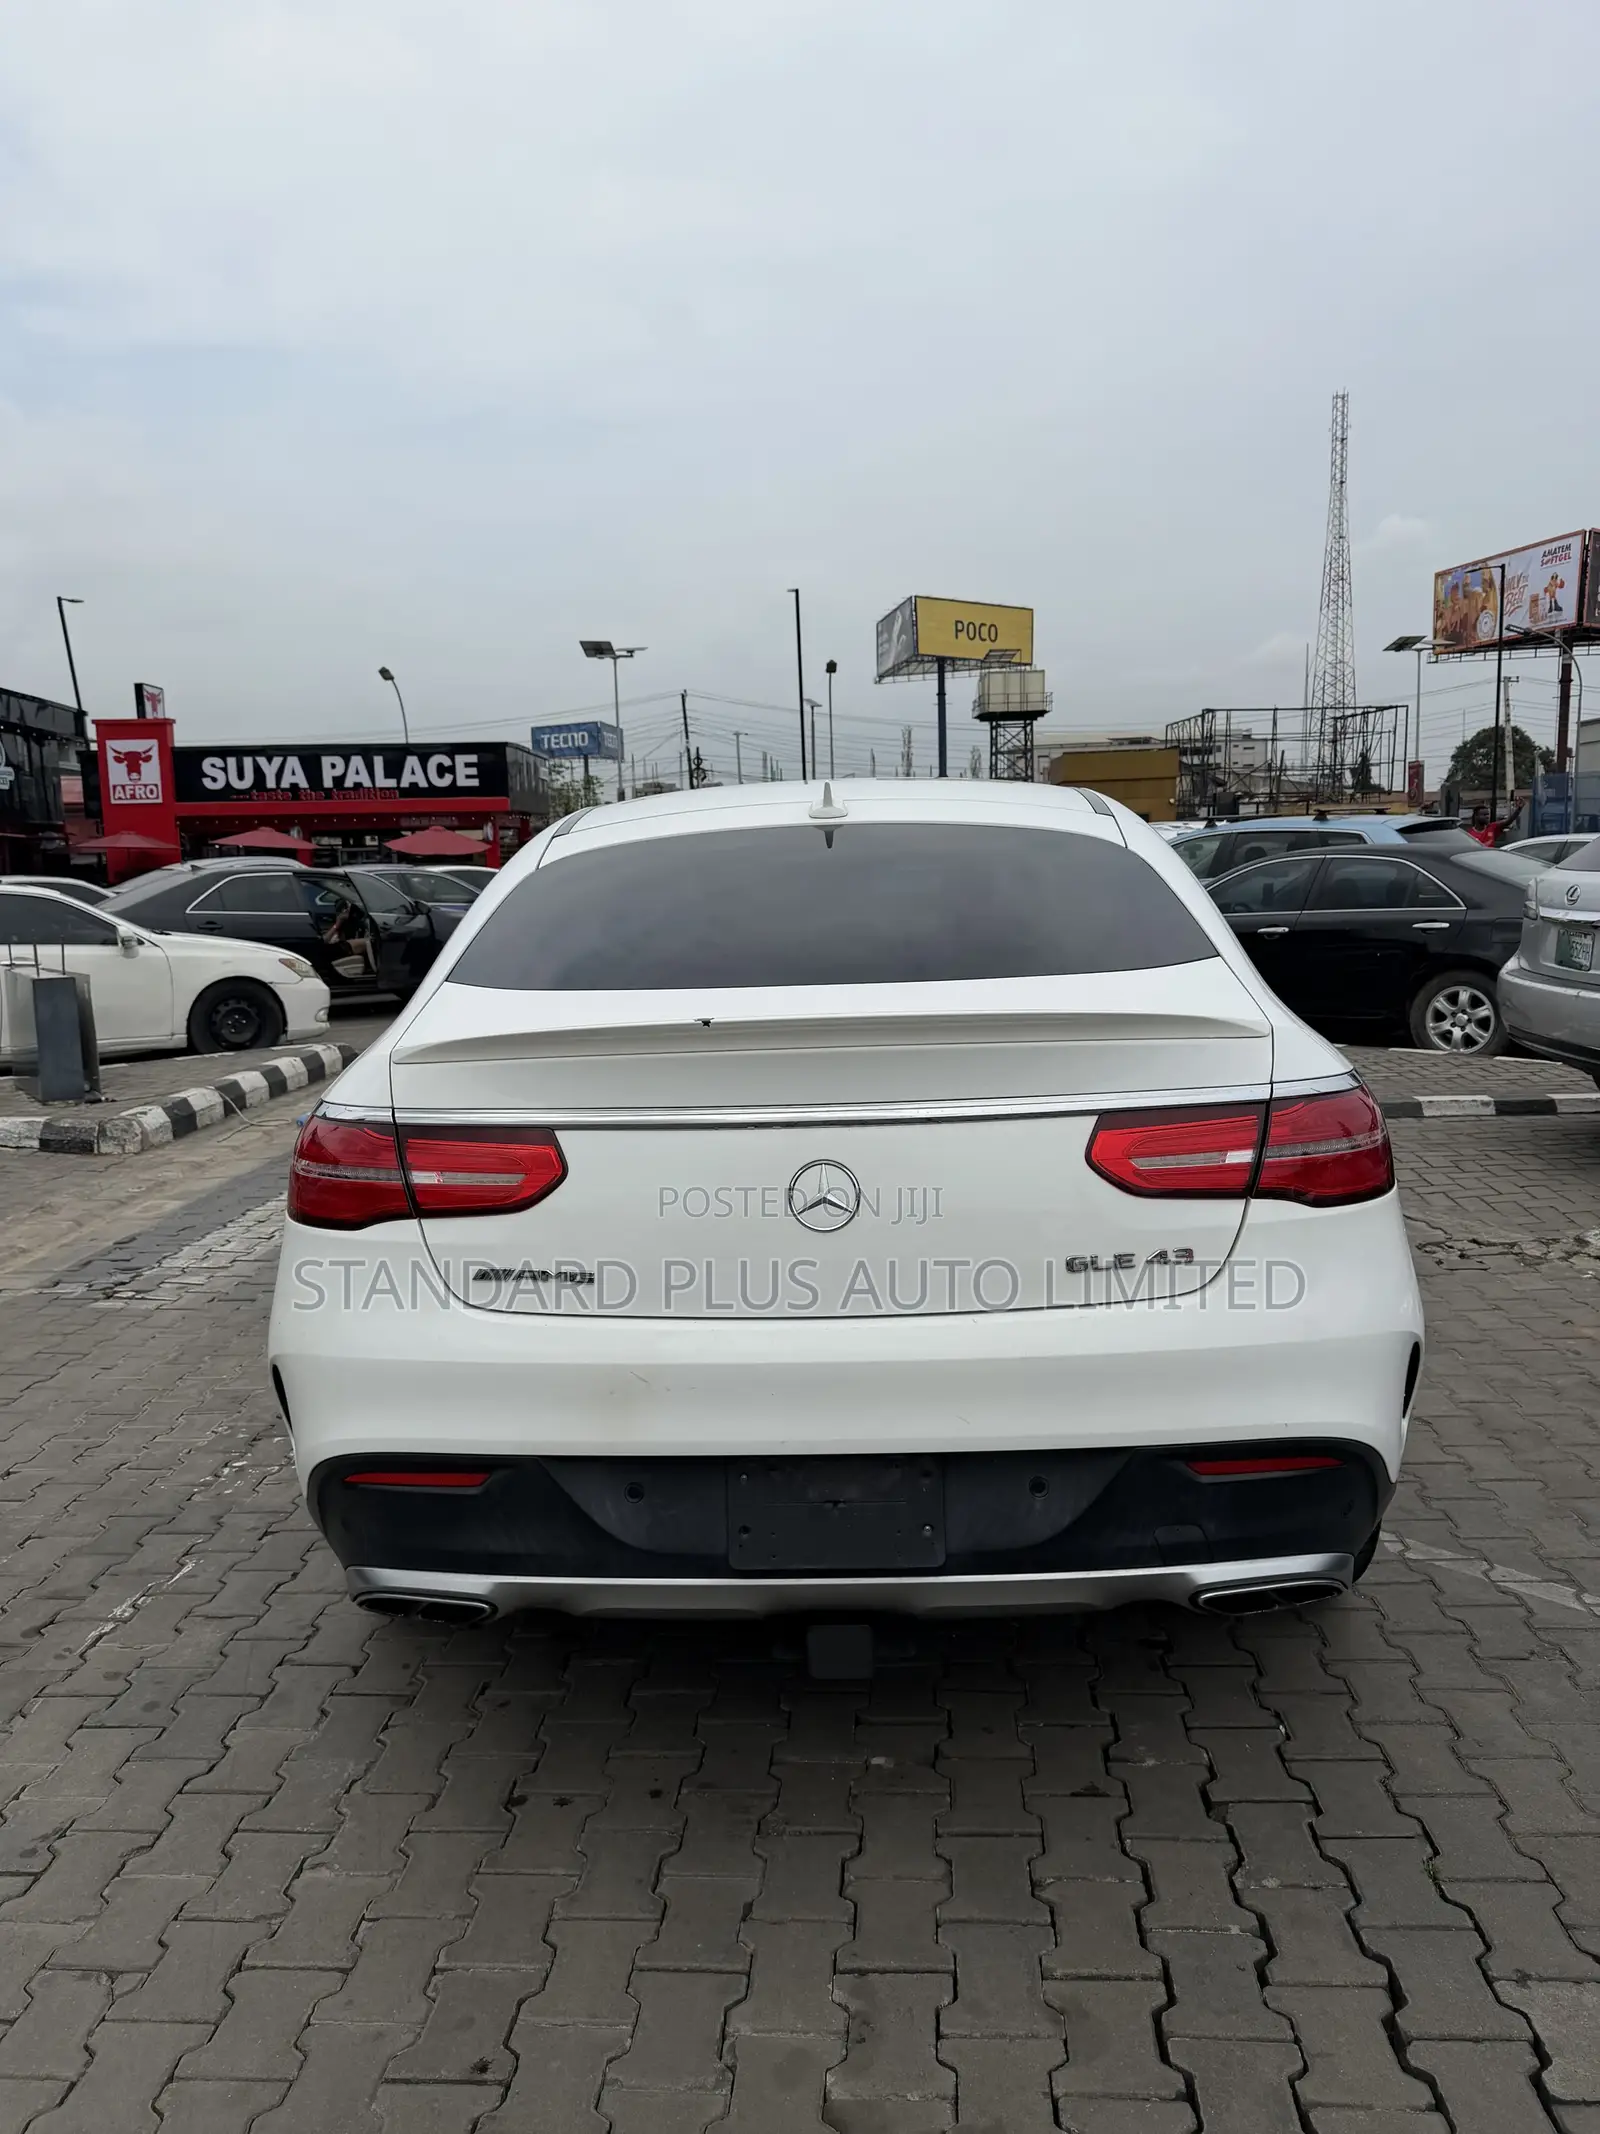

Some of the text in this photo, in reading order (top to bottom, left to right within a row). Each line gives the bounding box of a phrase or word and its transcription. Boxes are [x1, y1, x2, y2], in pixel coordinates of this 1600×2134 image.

[955, 619, 998, 643] POCO
[541, 731, 588, 749] TECNO
[201, 754, 480, 790] SUYA PALACE
[114, 784, 158, 800] AFRO
[1065, 1247, 1194, 1273] GLE 43
